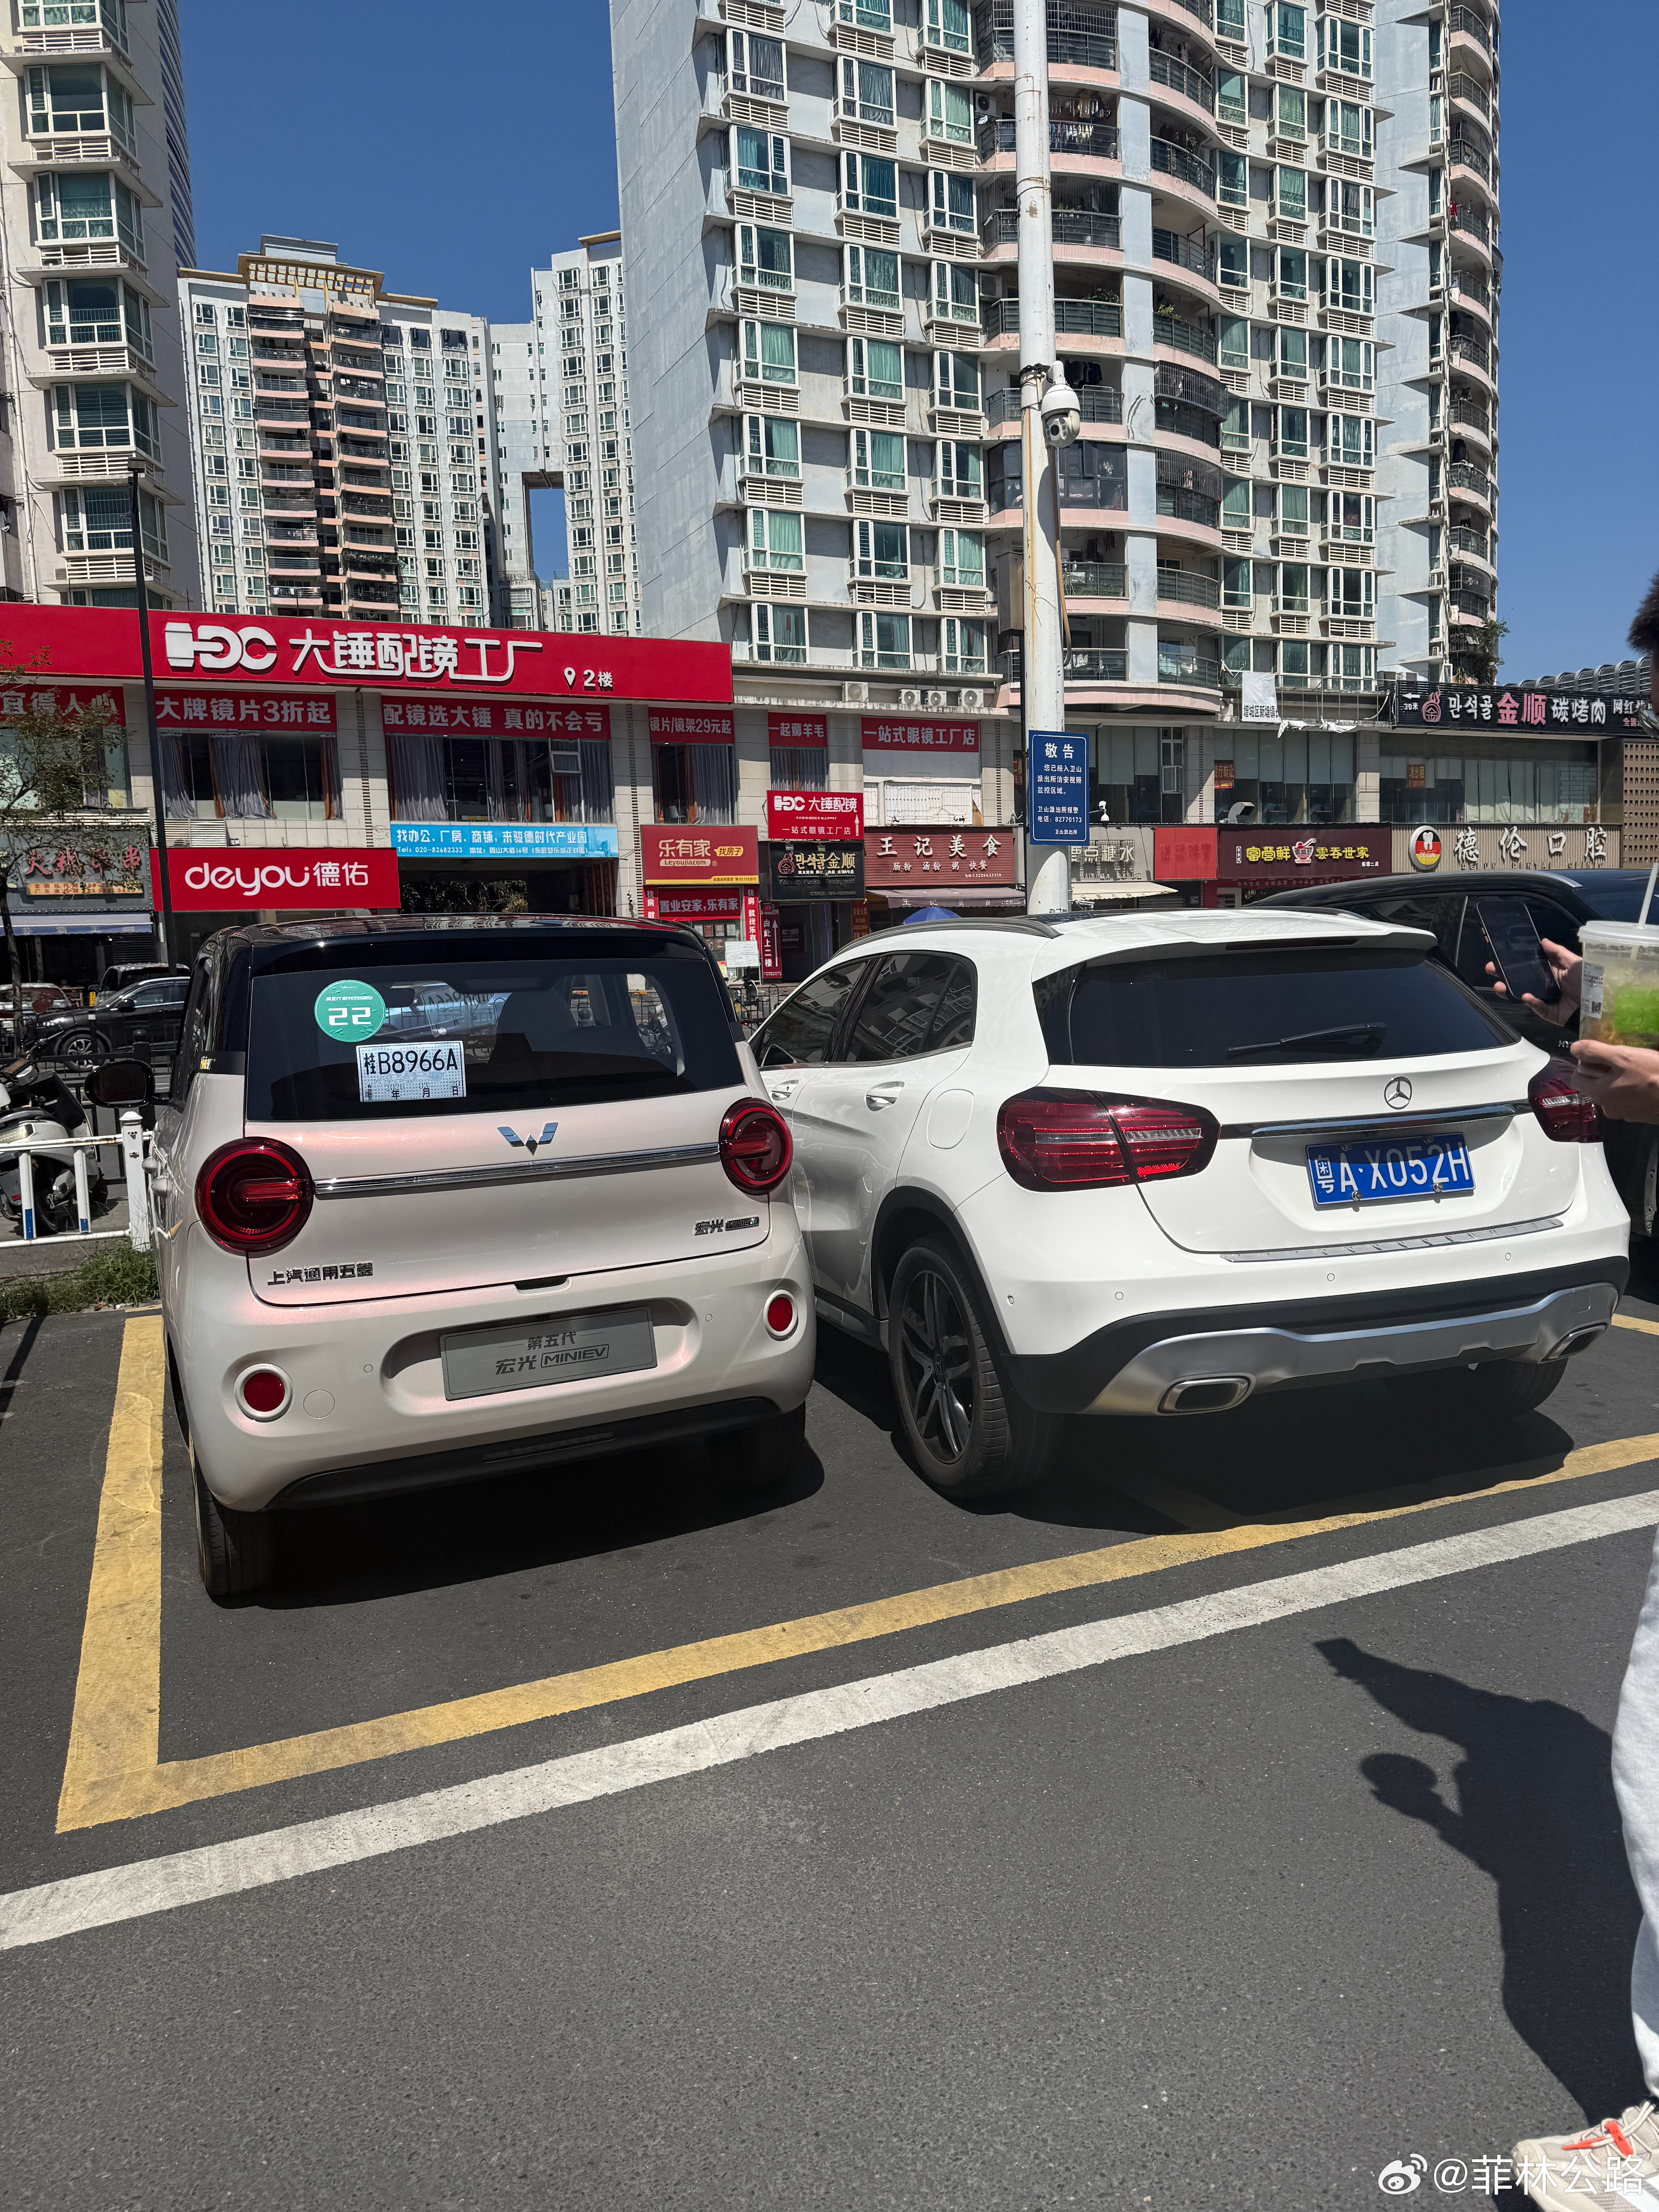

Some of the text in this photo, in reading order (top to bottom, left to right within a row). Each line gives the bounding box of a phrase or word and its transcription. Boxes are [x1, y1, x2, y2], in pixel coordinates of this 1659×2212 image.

[290, 629, 542, 682] 大锤配镜工厂
[584, 670, 613, 688] 2楼
[156, 697, 331, 725] 大牌镜片3折起
[383, 705, 603, 732] 配镜选大锤 真的不会亏
[1496, 692, 1547, 726] 金顺
[649, 716, 732, 734] 镜片/镜架29元起
[864, 725, 975, 745] 一站式眼镜工厂店
[1045, 742, 1074, 759] 敬告
[1037, 775, 1082, 784] 派出所治安视频
[808, 796, 857, 812] 大锤配镜
[782, 826, 851, 835] 一站式眼镜工厂店
[658, 839, 711, 857] 乐有家
[718, 847, 742, 856] 找房子
[876, 834, 1002, 857] 王记美食
[1456, 825, 1608, 862] 德伦口腔
[185, 862, 309, 896] deyou
[314, 861, 369, 887] 德佑
[328, 1007, 371, 1025] 22
[364, 1048, 458, 1075] 桂B8966A
[392, 1090, 400, 1099] 年
[422, 1088, 430, 1098] 月
[452, 1086, 459, 1096] 日
[527, 1331, 577, 1351] 第五代
[495, 1347, 607, 1375] 宏光 MINIEV
